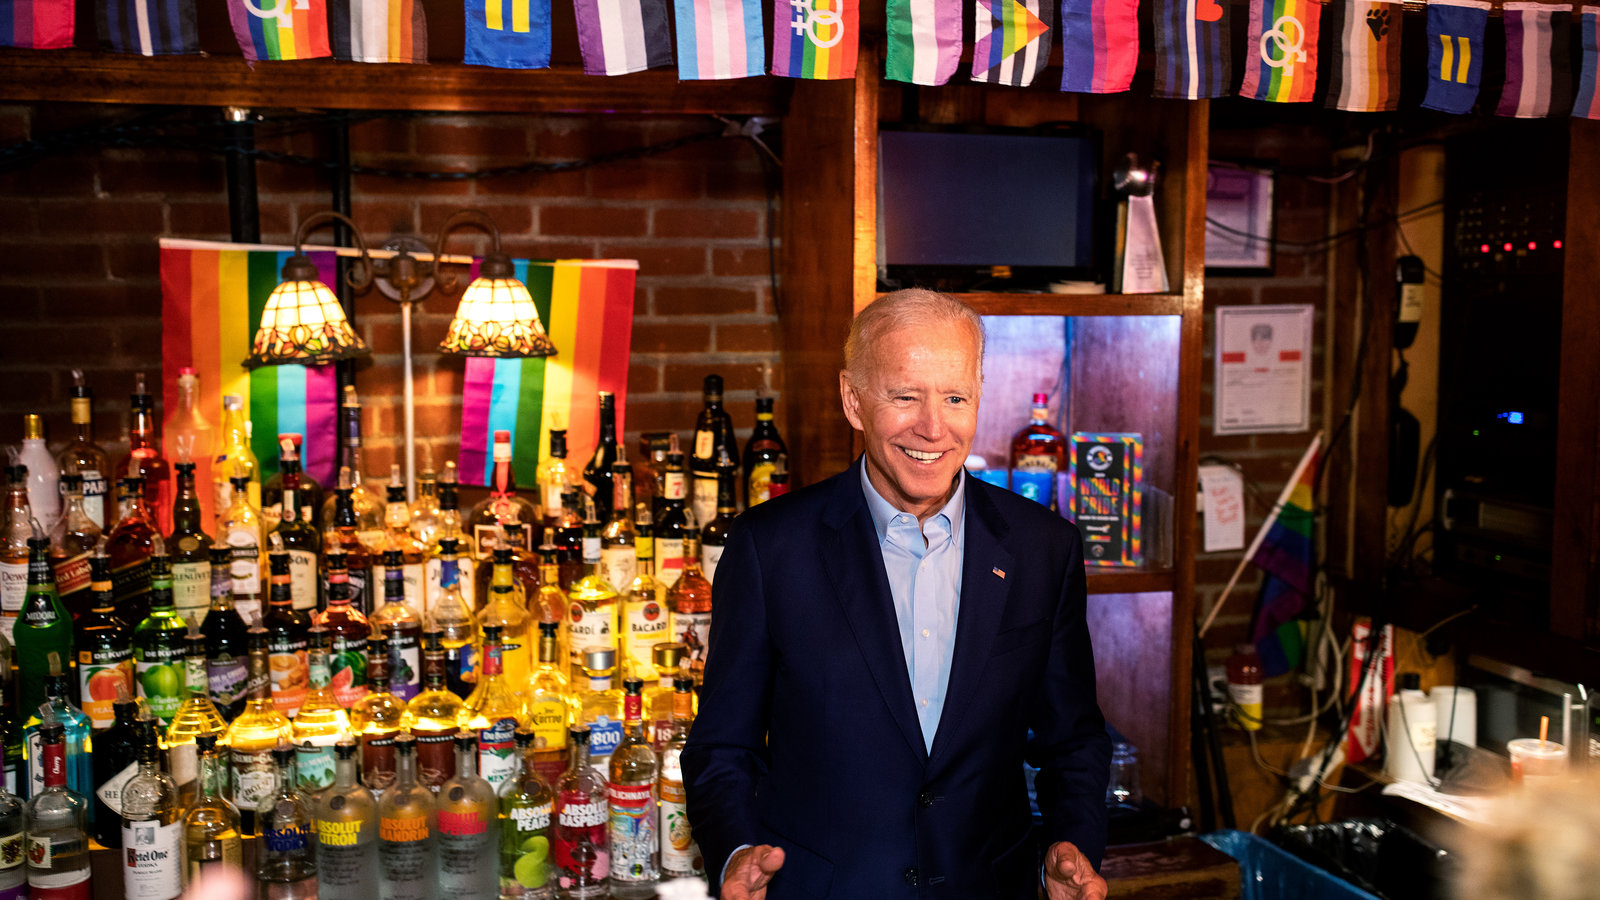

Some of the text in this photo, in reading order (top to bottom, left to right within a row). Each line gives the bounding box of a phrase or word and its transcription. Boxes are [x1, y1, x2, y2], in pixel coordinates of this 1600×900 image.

[1080, 478, 1120, 496] WORLD
[1080, 496, 1119, 514] PRIDE
[631, 621, 668, 633] BACARD
[127, 848, 168, 864] Ketel One
